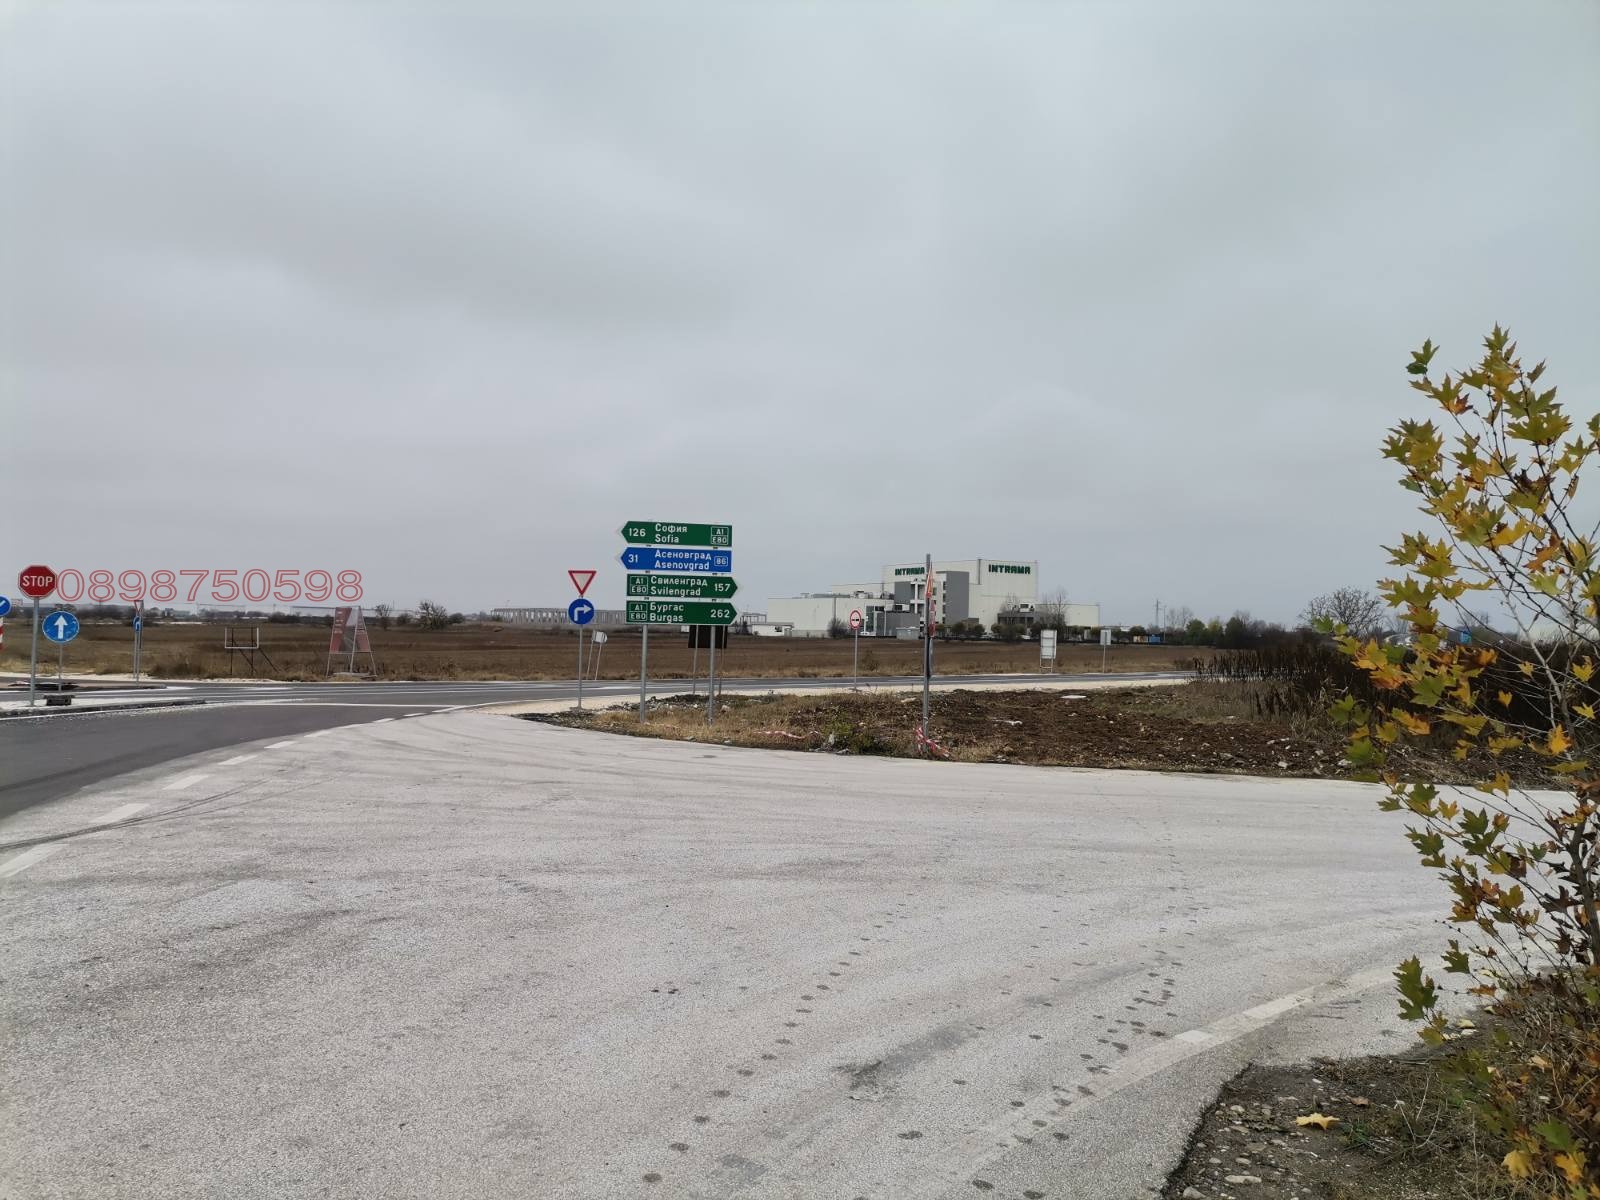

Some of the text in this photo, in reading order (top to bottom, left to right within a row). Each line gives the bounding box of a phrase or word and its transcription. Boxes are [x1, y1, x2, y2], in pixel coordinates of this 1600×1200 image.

[629, 528, 646, 537] 126
[655, 523, 688, 533] София
[655, 534, 680, 543] Sofia
[628, 554, 638, 563] 31
[655, 560, 710, 571] Asenovgrad
[22, 575, 53, 588] STOP
[650, 586, 701, 598] Svilengrad
[714, 583, 731, 592] 157
[649, 602, 684, 614] Бургас
[649, 613, 684, 624] Burgas
[710, 610, 730, 618] 262
